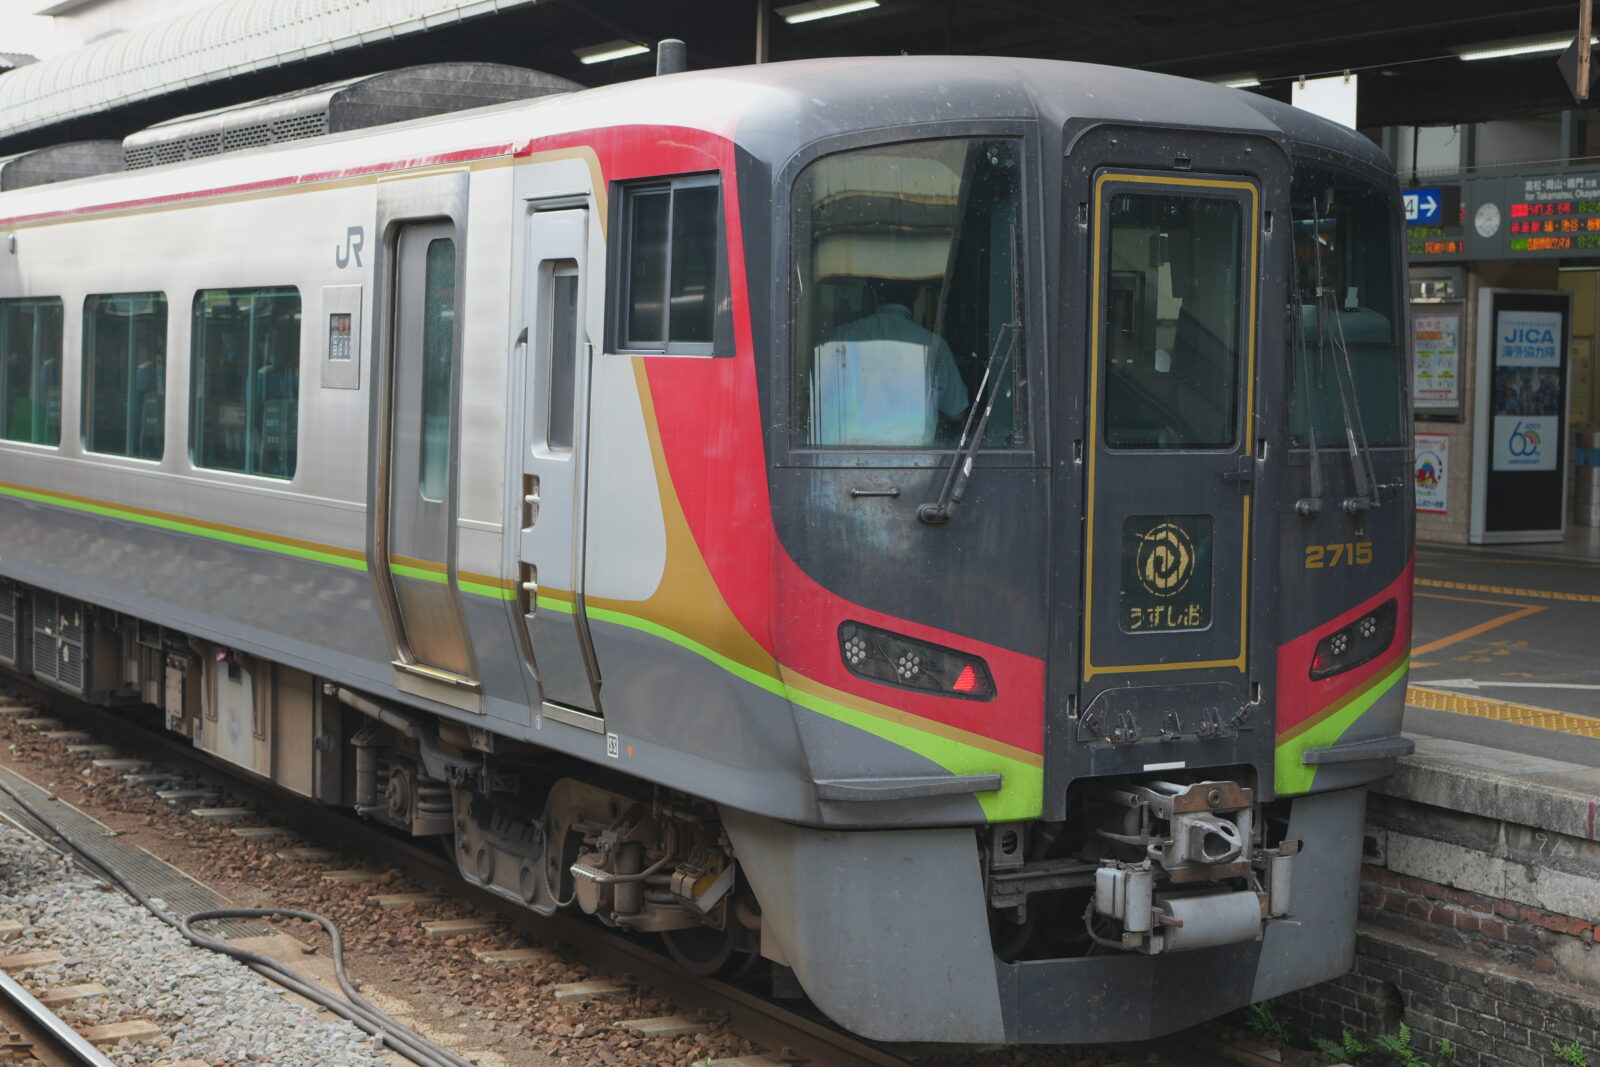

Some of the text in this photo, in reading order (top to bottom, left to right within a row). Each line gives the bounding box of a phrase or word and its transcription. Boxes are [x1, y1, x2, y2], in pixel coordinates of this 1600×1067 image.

[336, 226, 364, 269] JR
[1504, 328, 1553, 344] JICA
[1502, 345, 1555, 359] 海外協力隊
[1305, 542, 1373, 568] 2715
[1130, 604, 1203, 628] うずしお
